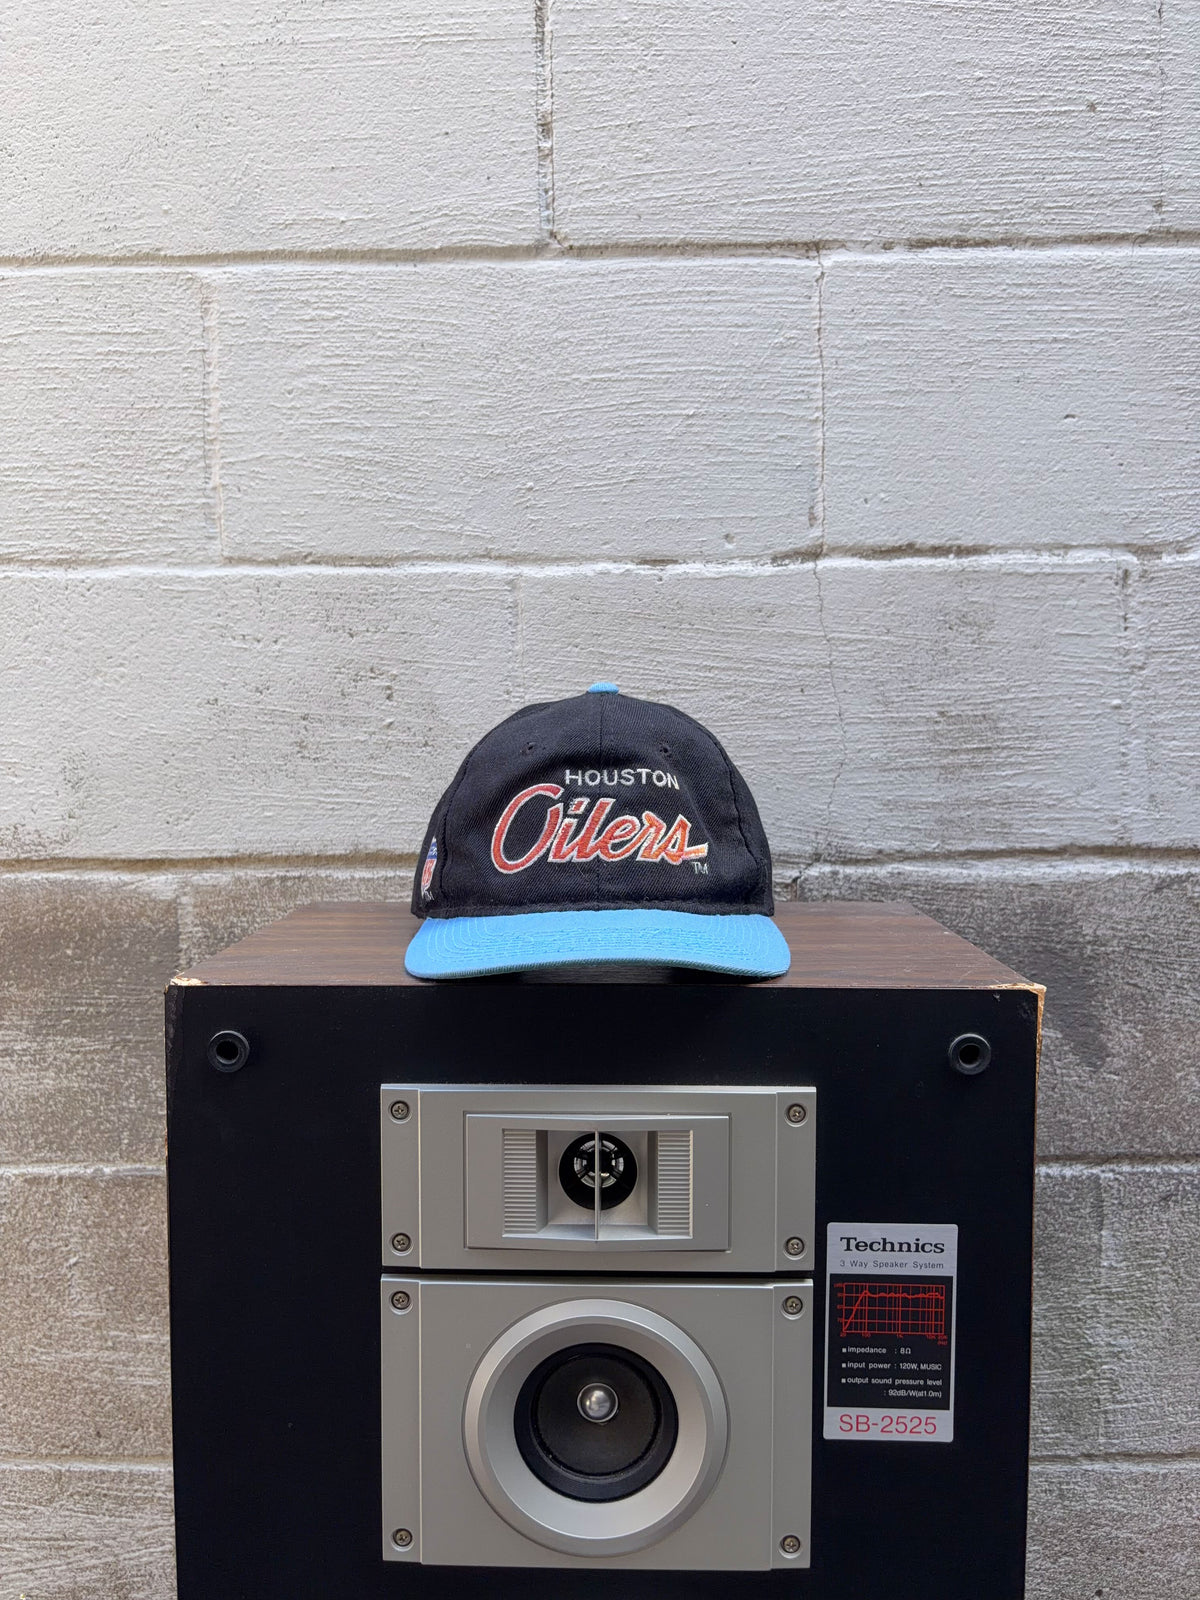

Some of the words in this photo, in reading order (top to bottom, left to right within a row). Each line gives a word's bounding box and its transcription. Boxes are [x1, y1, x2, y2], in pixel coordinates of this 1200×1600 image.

[565, 768, 680, 790] HOUSTON
[491, 782, 709, 875] Oilers
[691, 861, 709, 875] TM
[840, 1236, 945, 1253] Technics
[849, 1260, 868, 1268] Way
[873, 1260, 908, 1269] Speaker
[912, 1261, 944, 1270] System
[847, 1346, 887, 1354] impedance
[847, 1361, 866, 1369] input
[899, 1362, 919, 1370] 120W,
[839, 1413, 937, 1435] SB-2525
